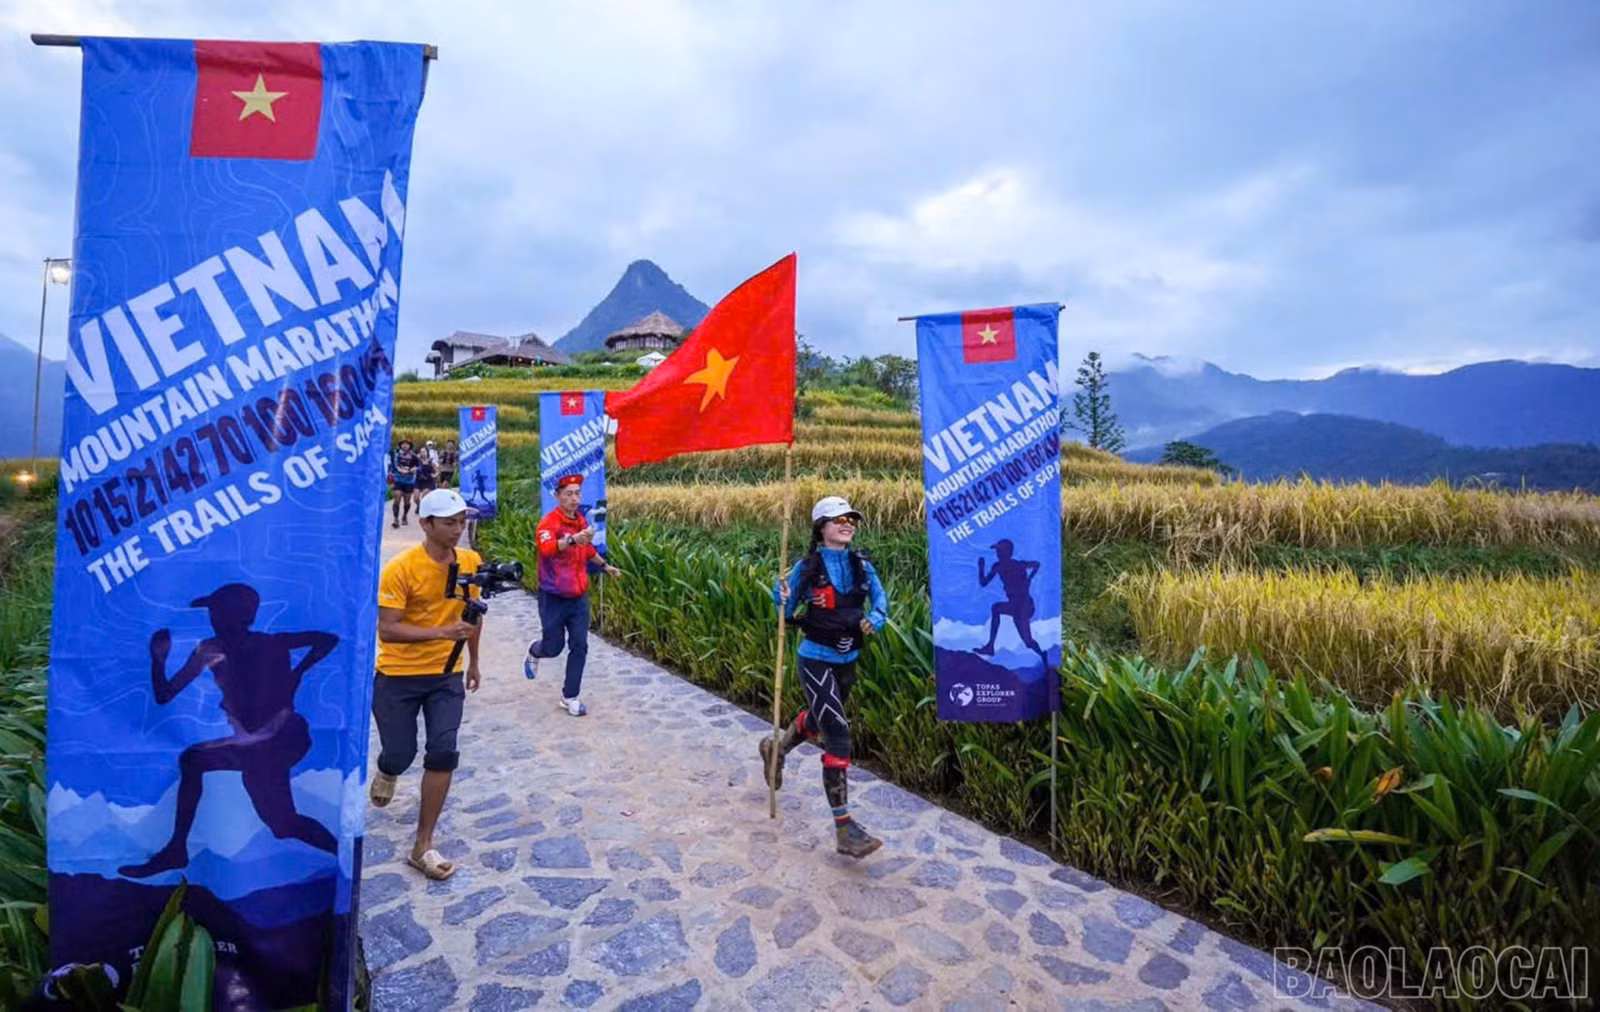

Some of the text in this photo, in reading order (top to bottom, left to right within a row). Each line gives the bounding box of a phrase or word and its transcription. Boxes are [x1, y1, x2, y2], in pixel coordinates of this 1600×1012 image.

[65, 168, 405, 415] VIETNAM
[60, 365, 233, 493] MOUNTAIN
[459, 421, 496, 451] VIETNAM
[540, 415, 606, 465] VIETNAM
[923, 359, 1058, 473] VIETNAM
[87, 535, 150, 594] THE
[148, 471, 282, 553] TRAILS
[283, 445, 328, 488] OF
[925, 451, 997, 505] MOUNTAIN
[946, 520, 974, 544] THE
[971, 492, 1018, 528] TRAILS
[1017, 480, 1035, 500] OF
